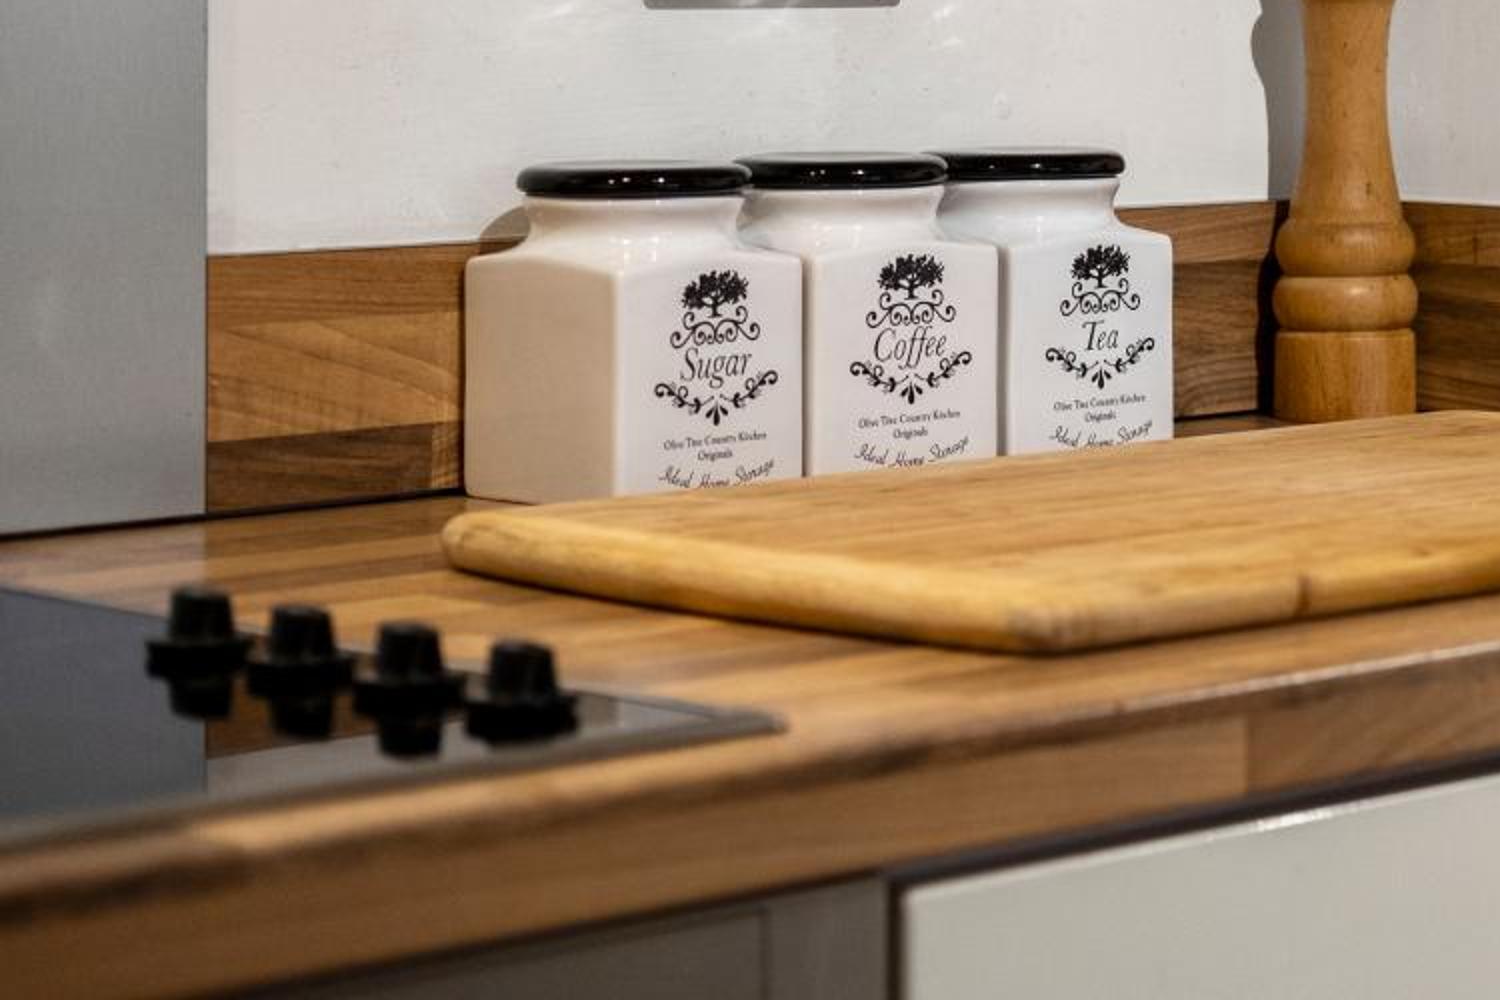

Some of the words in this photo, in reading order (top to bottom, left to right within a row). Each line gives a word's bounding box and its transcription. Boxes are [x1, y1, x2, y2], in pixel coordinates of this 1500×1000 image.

[873, 325, 947, 370] Coffee
[1082, 319, 1119, 351] Tea
[679, 347, 752, 389] Sugar
